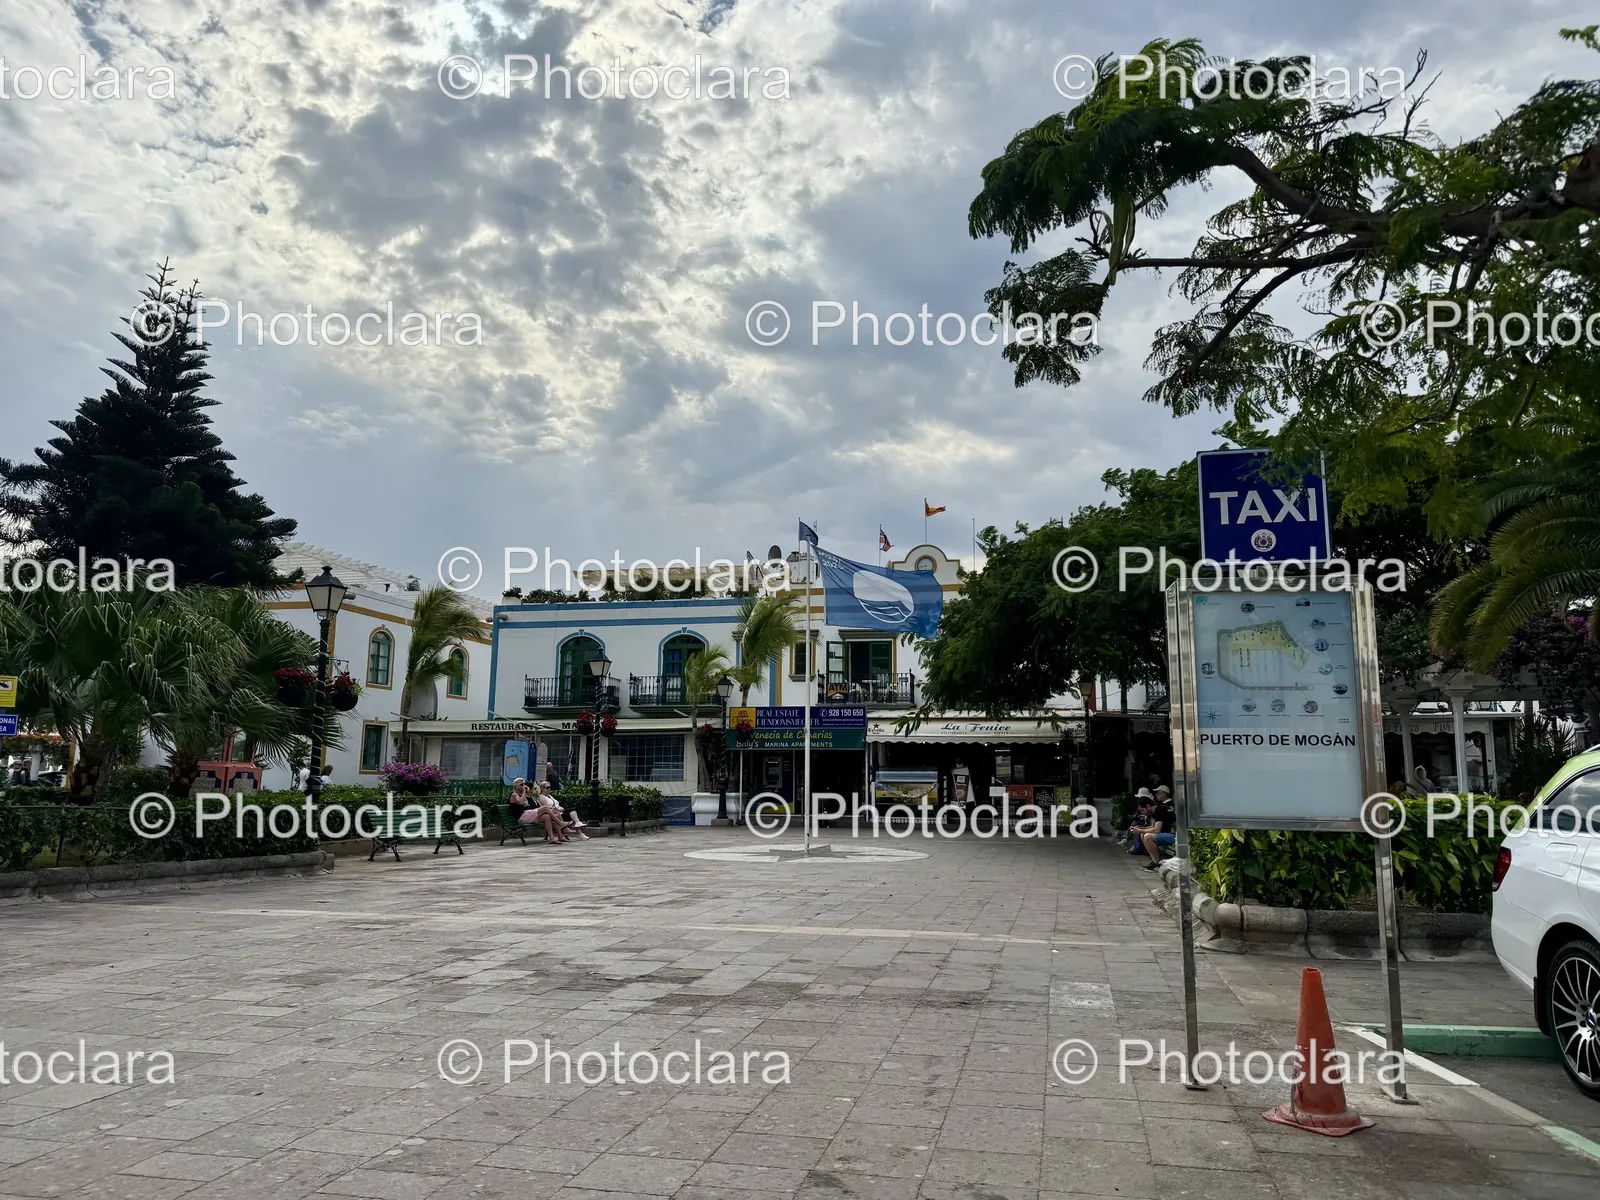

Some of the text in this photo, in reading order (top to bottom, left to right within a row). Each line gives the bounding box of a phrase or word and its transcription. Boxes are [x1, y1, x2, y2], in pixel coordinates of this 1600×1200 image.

[1209, 487, 1318, 525] TAXI
[829, 684, 847, 692] ATM
[757, 709, 799, 717] REAL ESTATE
[828, 708, 863, 717] 928 150 650
[471, 723, 541, 731] RESTAURANT
[941, 722, 1011, 732] La Fenice
[783, 730, 794, 739] de
[1200, 731, 1356, 747] PUERTO DE MOGÁN
